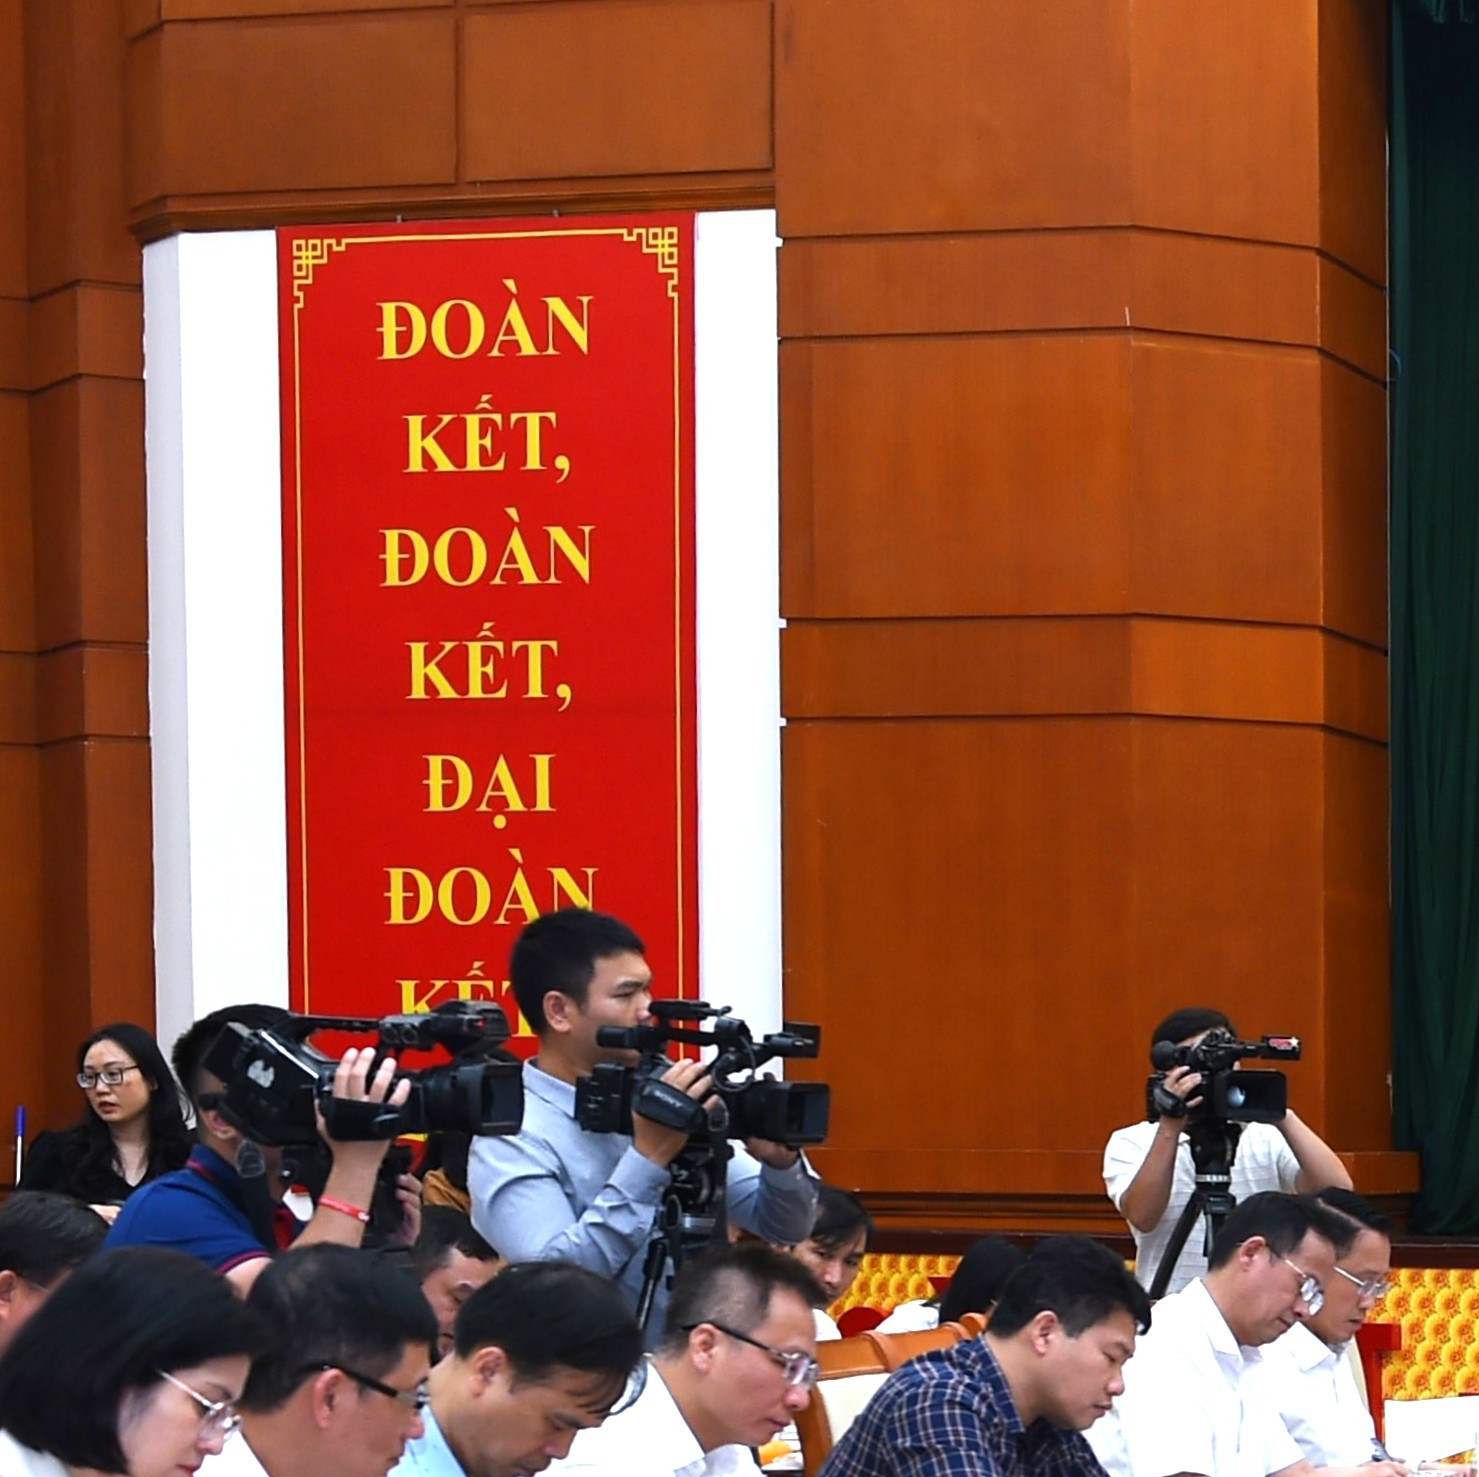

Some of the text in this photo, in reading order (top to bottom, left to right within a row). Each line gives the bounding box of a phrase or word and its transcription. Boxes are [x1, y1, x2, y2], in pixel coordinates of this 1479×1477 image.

[376, 278, 593, 360] ĐOÀN
[403, 394, 571, 483] KẾT,
[379, 507, 595, 587] ĐOÀN
[405, 622, 573, 711] KẾT,
[423, 754, 555, 829] ĐẠI
[384, 848, 599, 926] ĐOÀN
